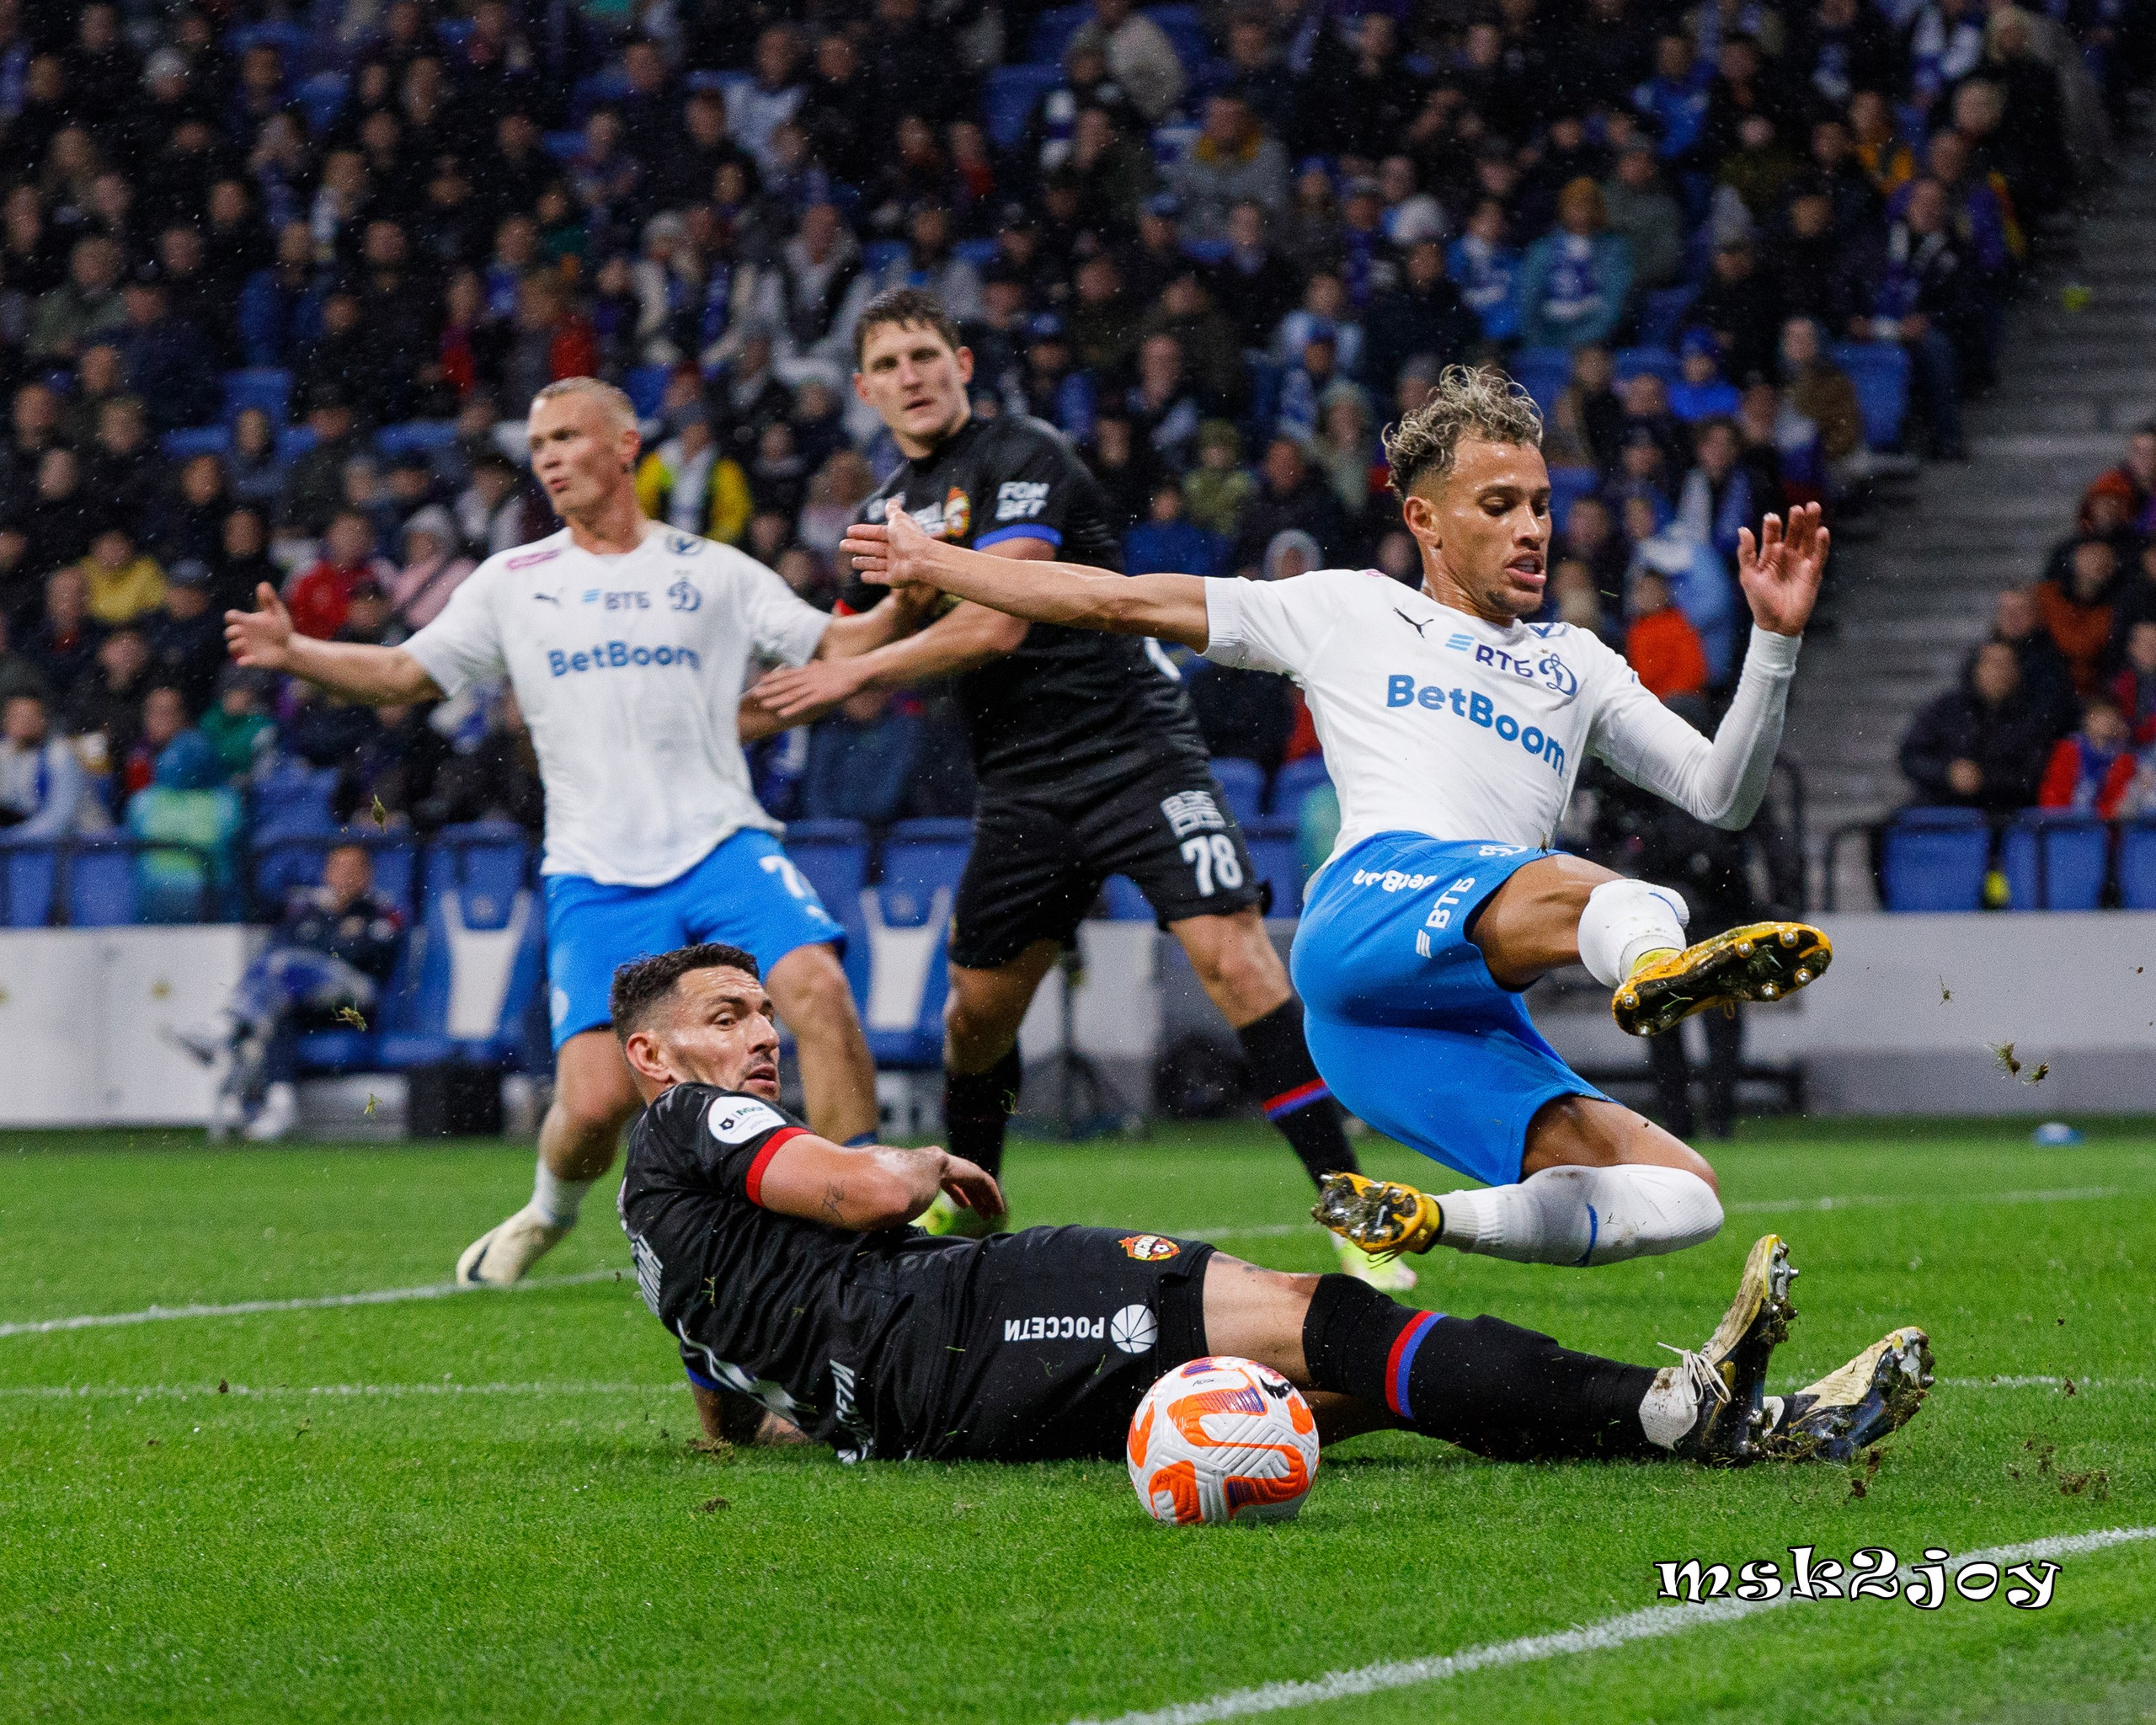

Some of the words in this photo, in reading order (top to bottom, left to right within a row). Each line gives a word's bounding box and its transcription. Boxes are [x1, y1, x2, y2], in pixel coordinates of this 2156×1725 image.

[1386, 674, 1565, 777] BetBoom
[1180, 833, 1244, 897] 78
[1425, 877, 1476, 928] ВТБ
[1003, 1316, 1106, 1342] РОССЕТИ
